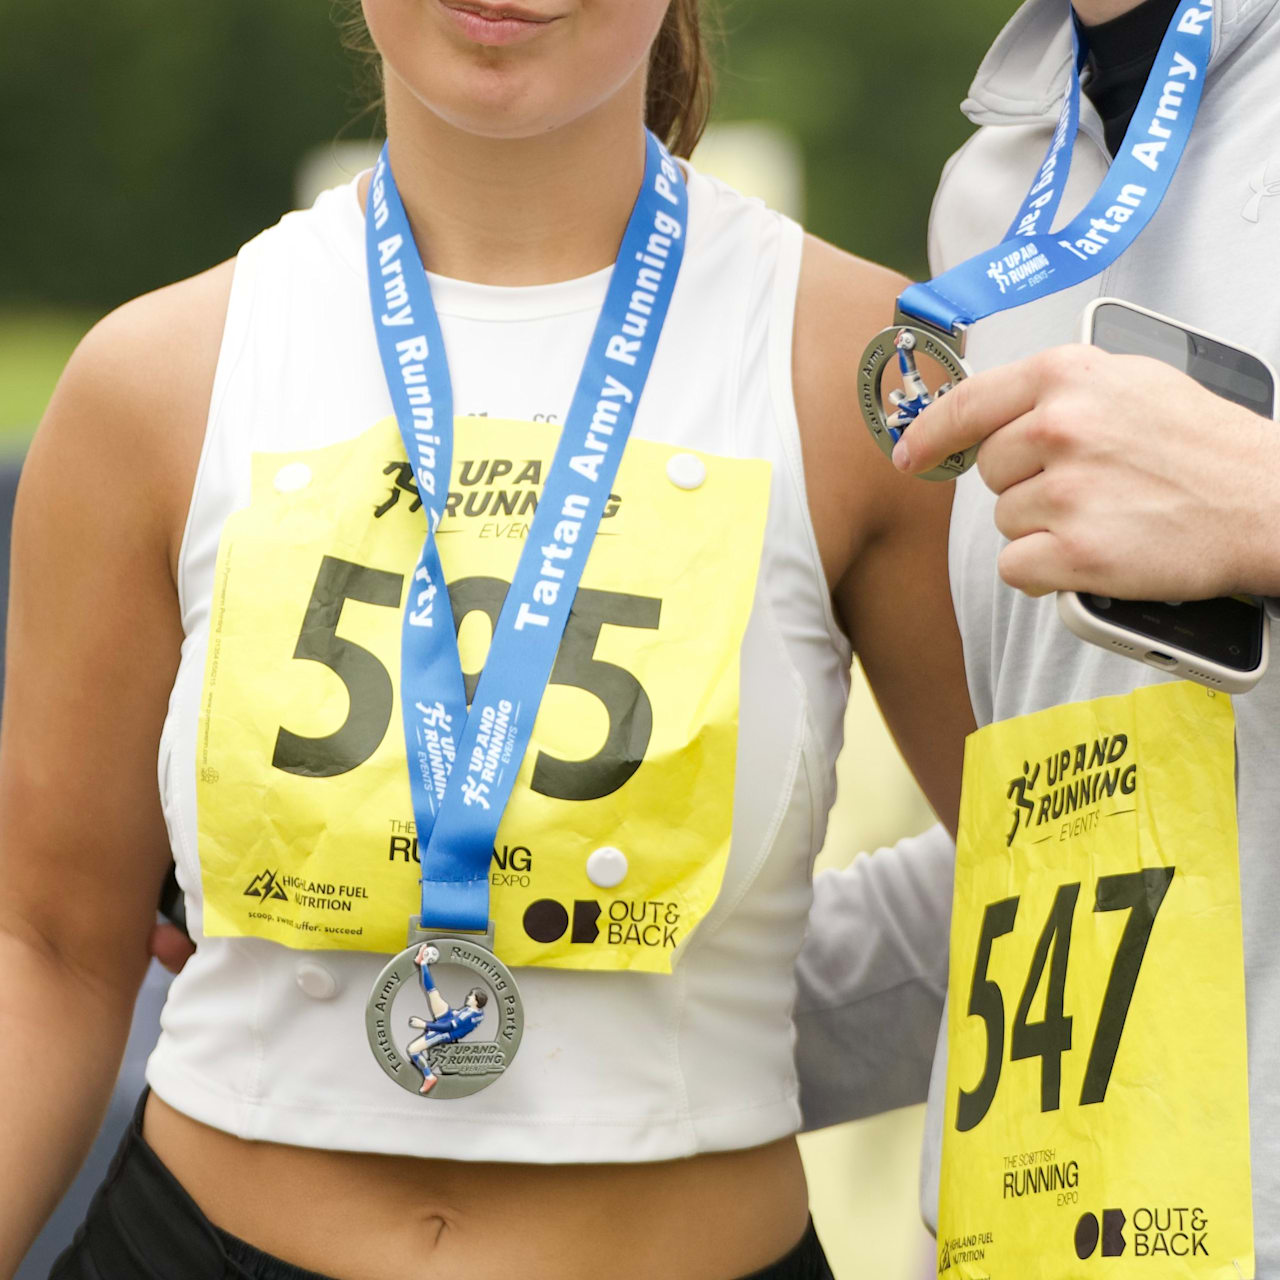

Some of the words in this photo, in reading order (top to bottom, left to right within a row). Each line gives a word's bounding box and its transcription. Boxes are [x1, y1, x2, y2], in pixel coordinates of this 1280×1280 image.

[1057, 183, 1147, 261] Tartan
[1131, 51, 1197, 172] Army
[1016, 189, 1054, 236] Par
[1003, 251, 1021, 269] UP
[377, 233, 414, 327] Army
[863, 344, 885, 380] Army
[925, 340, 963, 382] Runni
[395, 335, 441, 495] Running
[514, 493, 590, 631] Tartan
[569, 374, 633, 483] Army
[605, 210, 682, 365] Running
[457, 459, 513, 487] UP
[446, 489, 622, 519] RUNNG
[476, 706, 495, 748] AND
[481, 699, 512, 784] RUNNING
[501, 725, 518, 764] EVENTS
[418, 751, 433, 791] EVENTS
[469, 746, 485, 772] UP
[1045, 749, 1071, 787] UP
[1072, 733, 1128, 776] AND
[1036, 763, 1136, 826] RUNNING
[339, 885, 369, 899] FUEL
[491, 873, 530, 888] EXPO
[296, 922, 321, 932] uffer.
[324, 926, 363, 936] succeed
[608, 900, 681, 924] OUT&
[607, 923, 680, 948] BACK
[451, 946, 507, 992] Running
[375, 971, 401, 1013] Army
[954, 866, 1176, 1132] 547
[502, 995, 518, 1041] Party
[375, 1020, 402, 1073] Tartan
[448, 1055, 503, 1065] RUNNING
[454, 1045, 471, 1055] UP
[470, 1045, 498, 1055] AND
[1003, 1160, 1079, 1199] RUNNING
[1057, 1191, 1079, 1207] EXPO
[1132, 1207, 1209, 1232] OUT&
[1134, 1232, 1209, 1257] BACK
